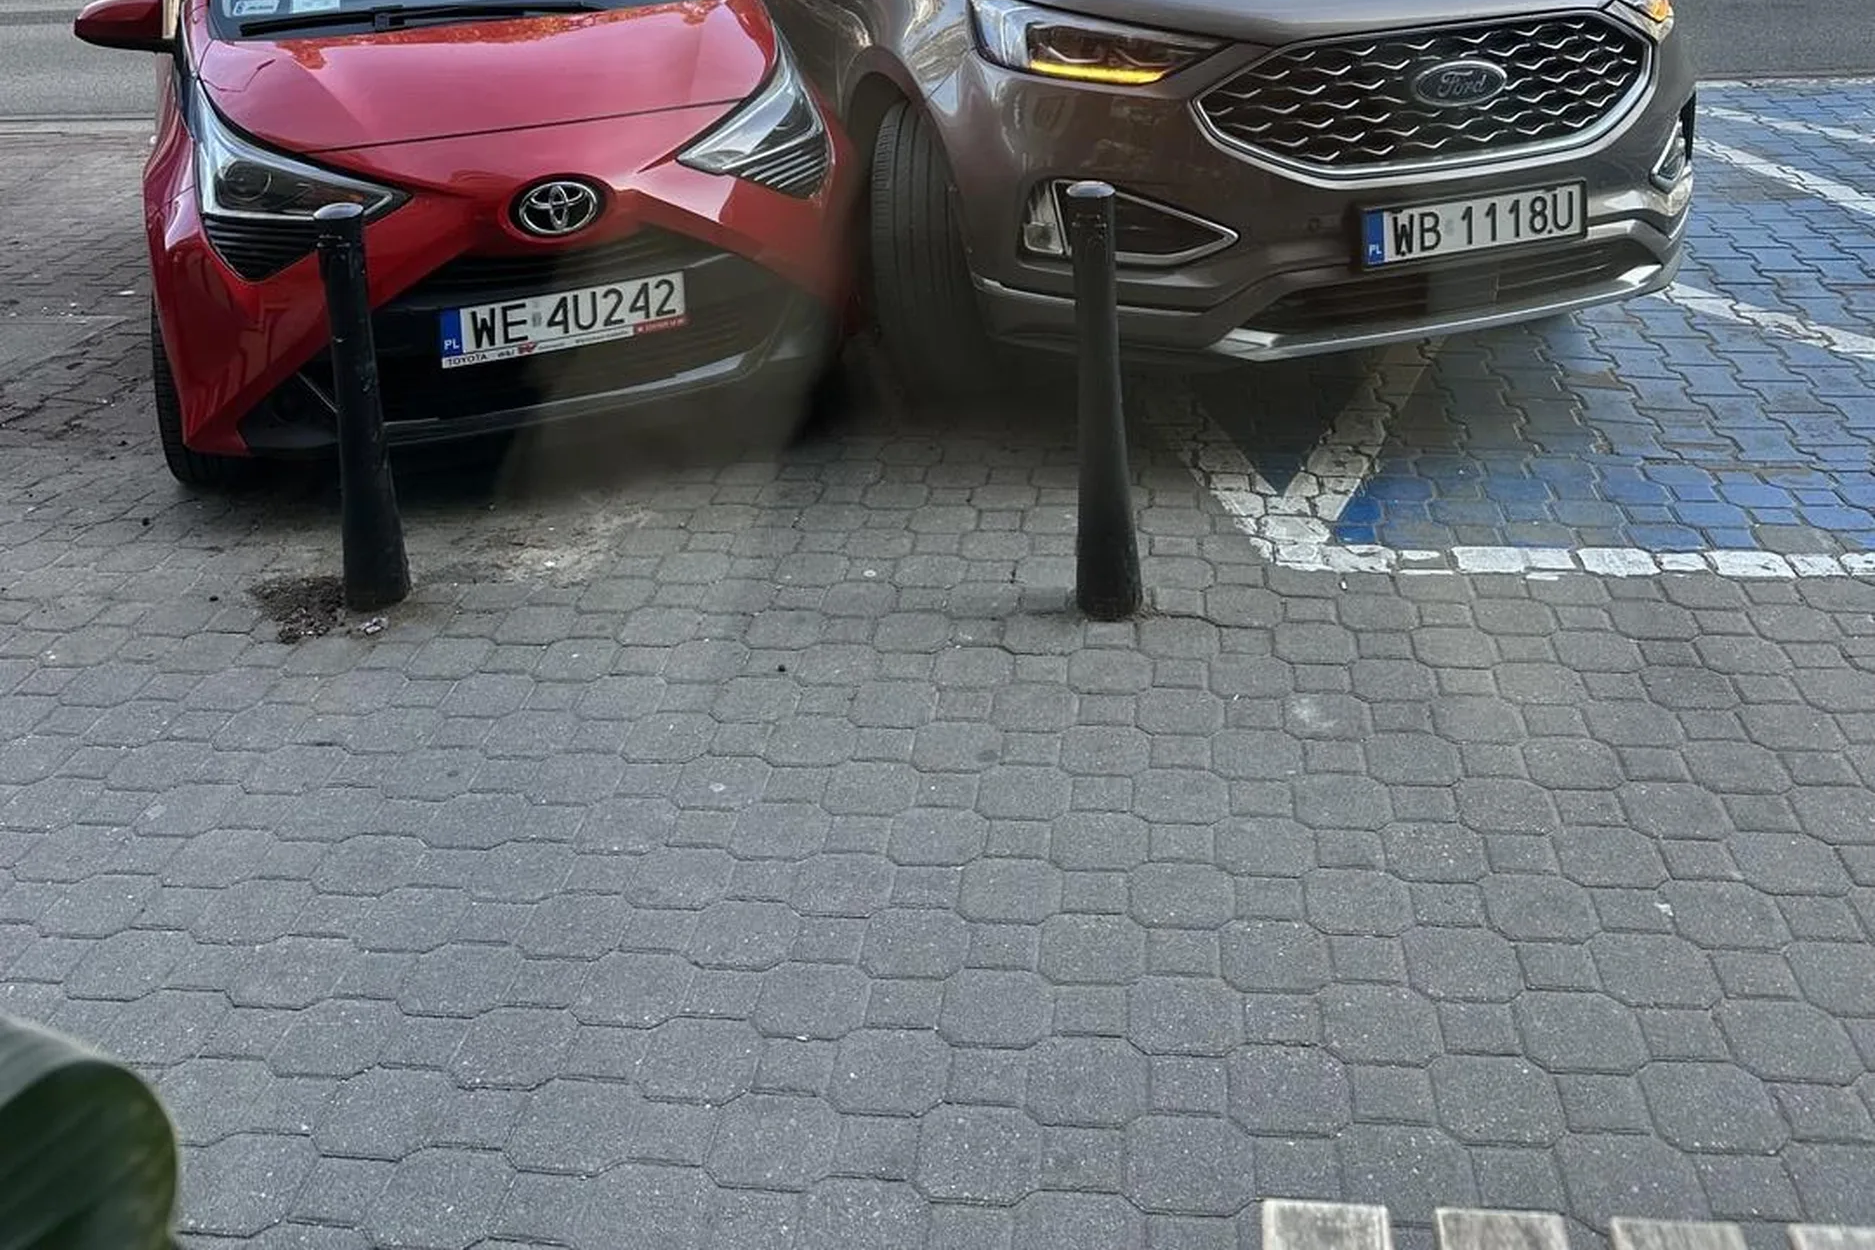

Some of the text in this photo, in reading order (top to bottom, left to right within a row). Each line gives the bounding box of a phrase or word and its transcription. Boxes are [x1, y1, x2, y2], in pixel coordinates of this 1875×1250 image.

[1437, 69, 1487, 98] Ford
[1392, 190, 1574, 257] WB 1118U
[1368, 243, 1382, 256] PL
[470, 278, 677, 349] WE 4U242
[443, 338, 460, 351] PL
[447, 352, 487, 366] TOYOTA
